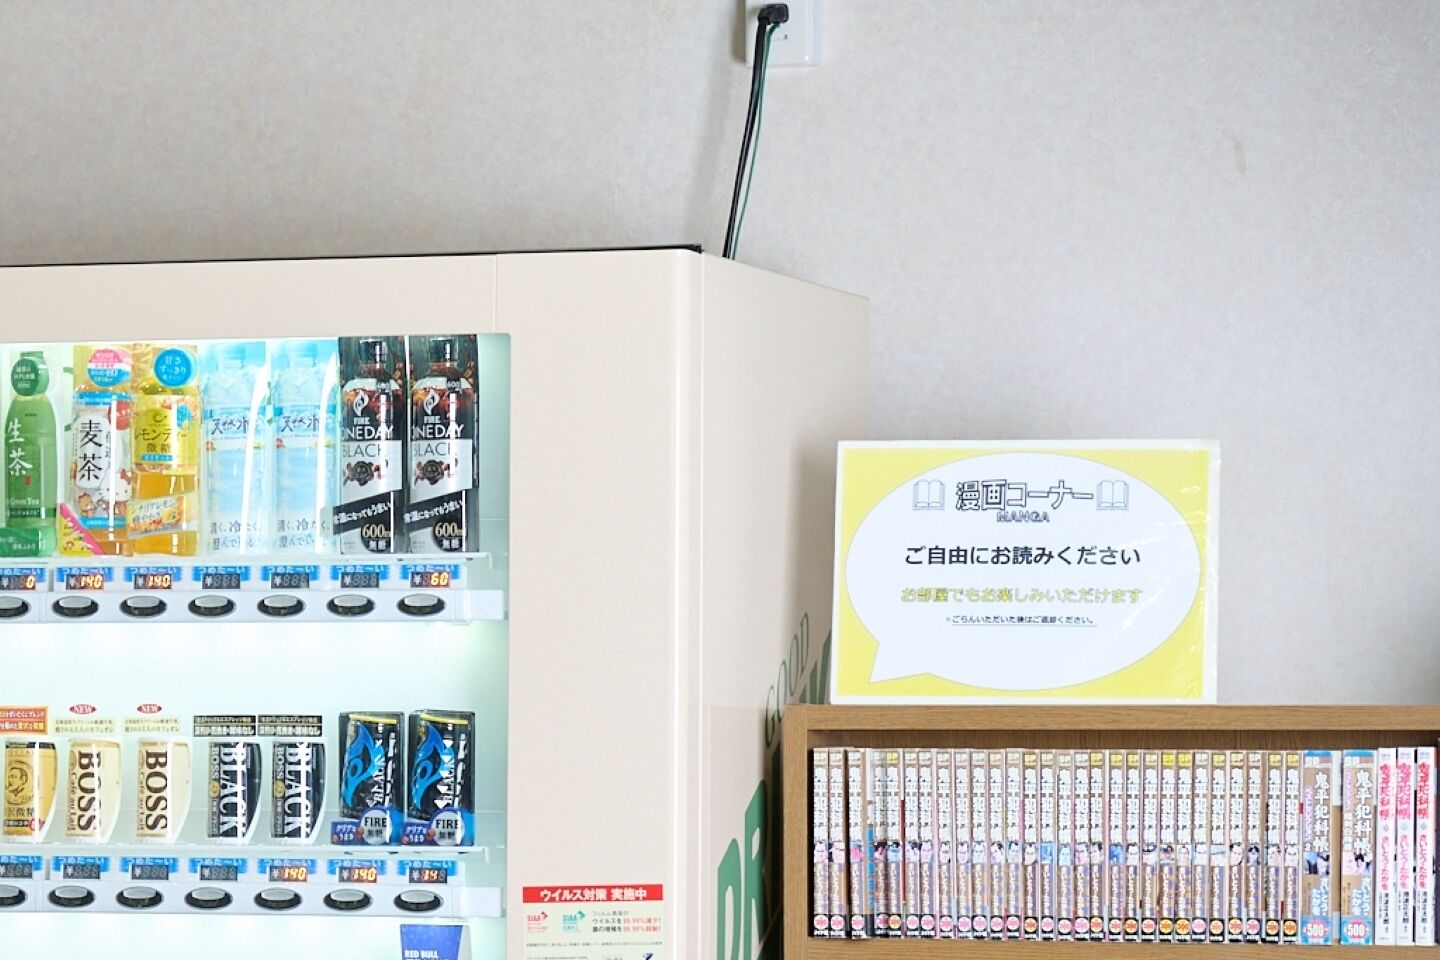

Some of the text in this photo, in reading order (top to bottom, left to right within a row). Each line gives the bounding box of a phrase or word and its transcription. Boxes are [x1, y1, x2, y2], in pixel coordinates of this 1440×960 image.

[7, 417, 33, 476] 生茶
[78, 419, 103, 481] 麦茶
[954, 478, 1094, 512] 漫画コーナー
[996, 511, 1050, 523] MANGA
[905, 545, 1141, 566] ご自由にお読みください
[900, 587, 1144, 604] お部屋でもお楽しみいただけます
[74, 705, 92, 714] NEW
[142, 704, 158, 713] NEW
[145, 750, 168, 831] BOSS
[1313, 770, 1330, 853] 鬼平犯科帳
[364, 816, 388, 827] FIRE
[1347, 924, 1366, 938] 500
[404, 950, 439, 959] RED BULL
